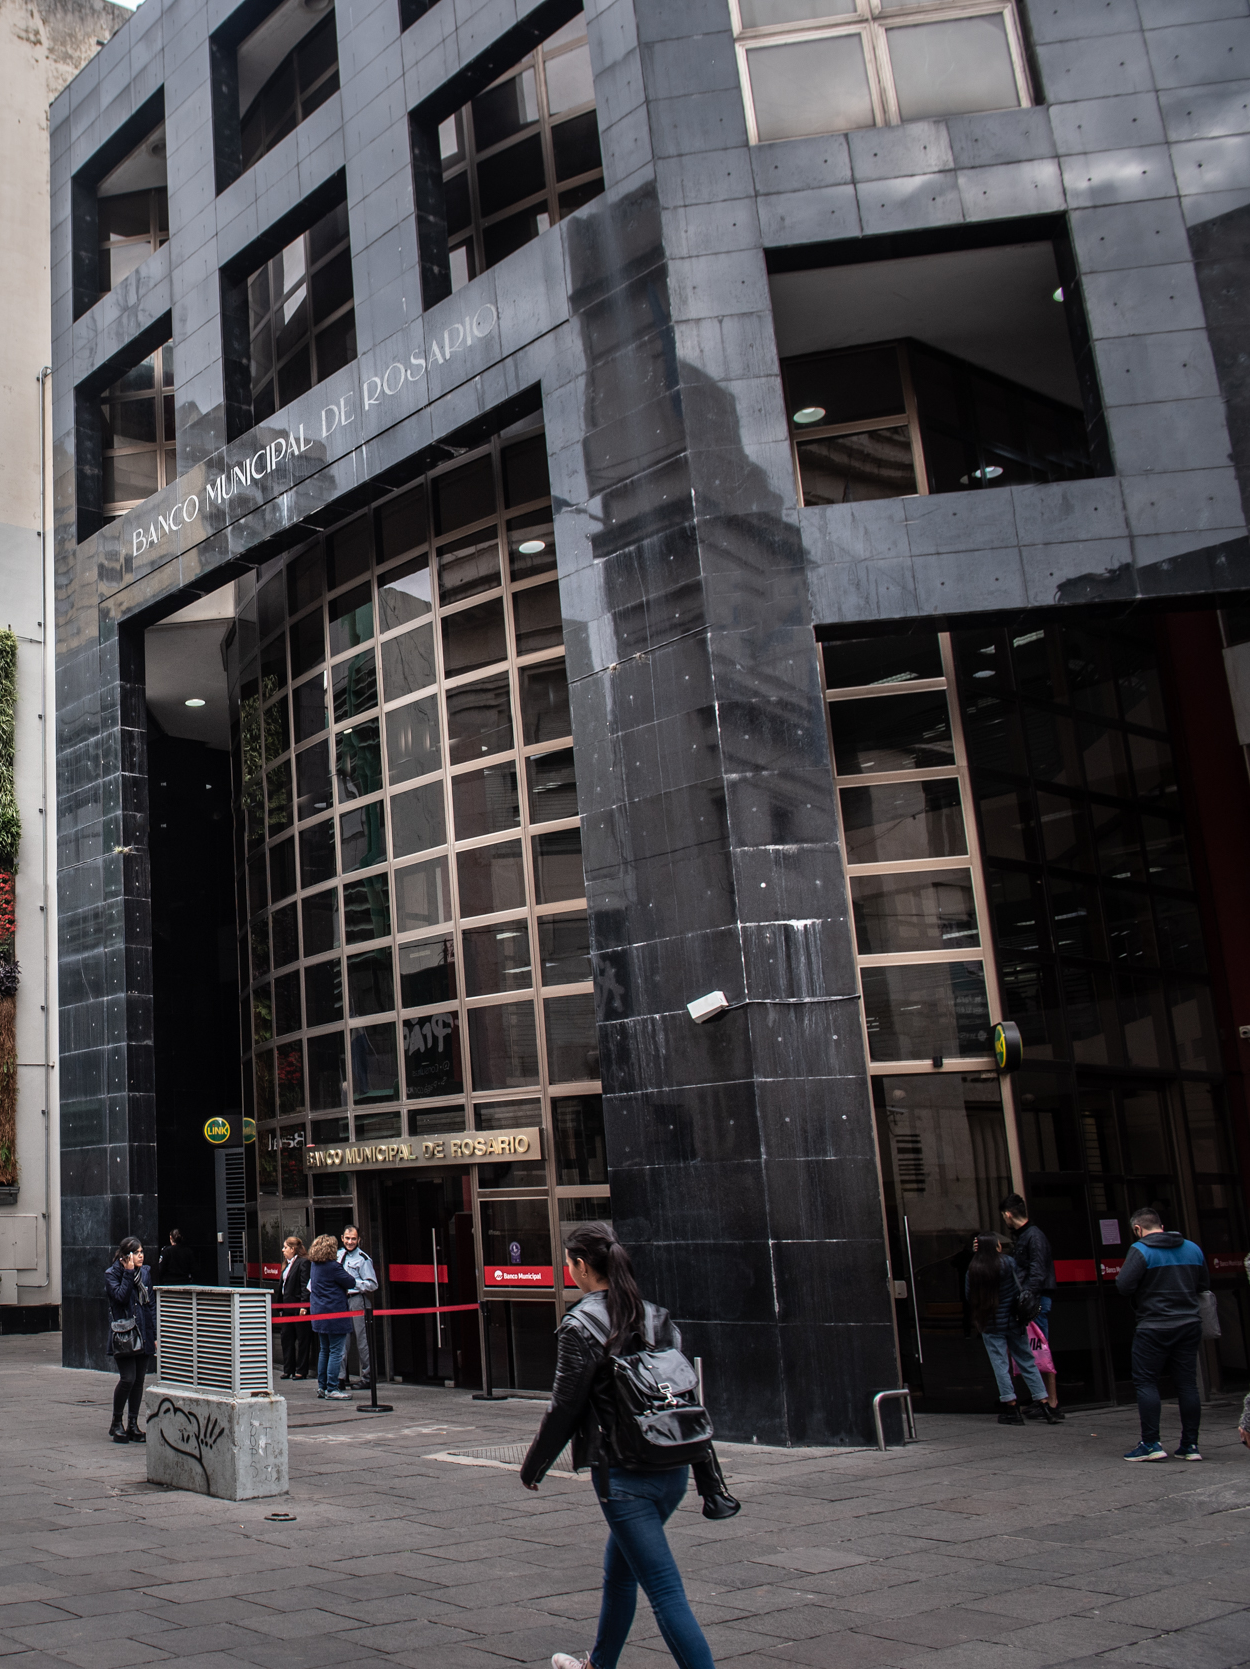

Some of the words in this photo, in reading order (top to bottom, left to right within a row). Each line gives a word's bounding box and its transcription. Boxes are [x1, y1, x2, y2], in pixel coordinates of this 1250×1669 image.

[132, 494, 200, 557] BANCO
[205, 423, 314, 511] MUNICIPAL
[321, 390, 355, 439] DE
[363, 302, 498, 412] ROSARIO
[207, 1124, 228, 1135] LINK
[306, 1149, 343, 1167] BANCO
[345, 1143, 417, 1164] MUNICIPAL
[422, 1140, 445, 1159] DE
[451, 1135, 530, 1158] ROSARIO
[503, 1272, 518, 1280] Banco
[518, 1272, 542, 1281] Municipal
